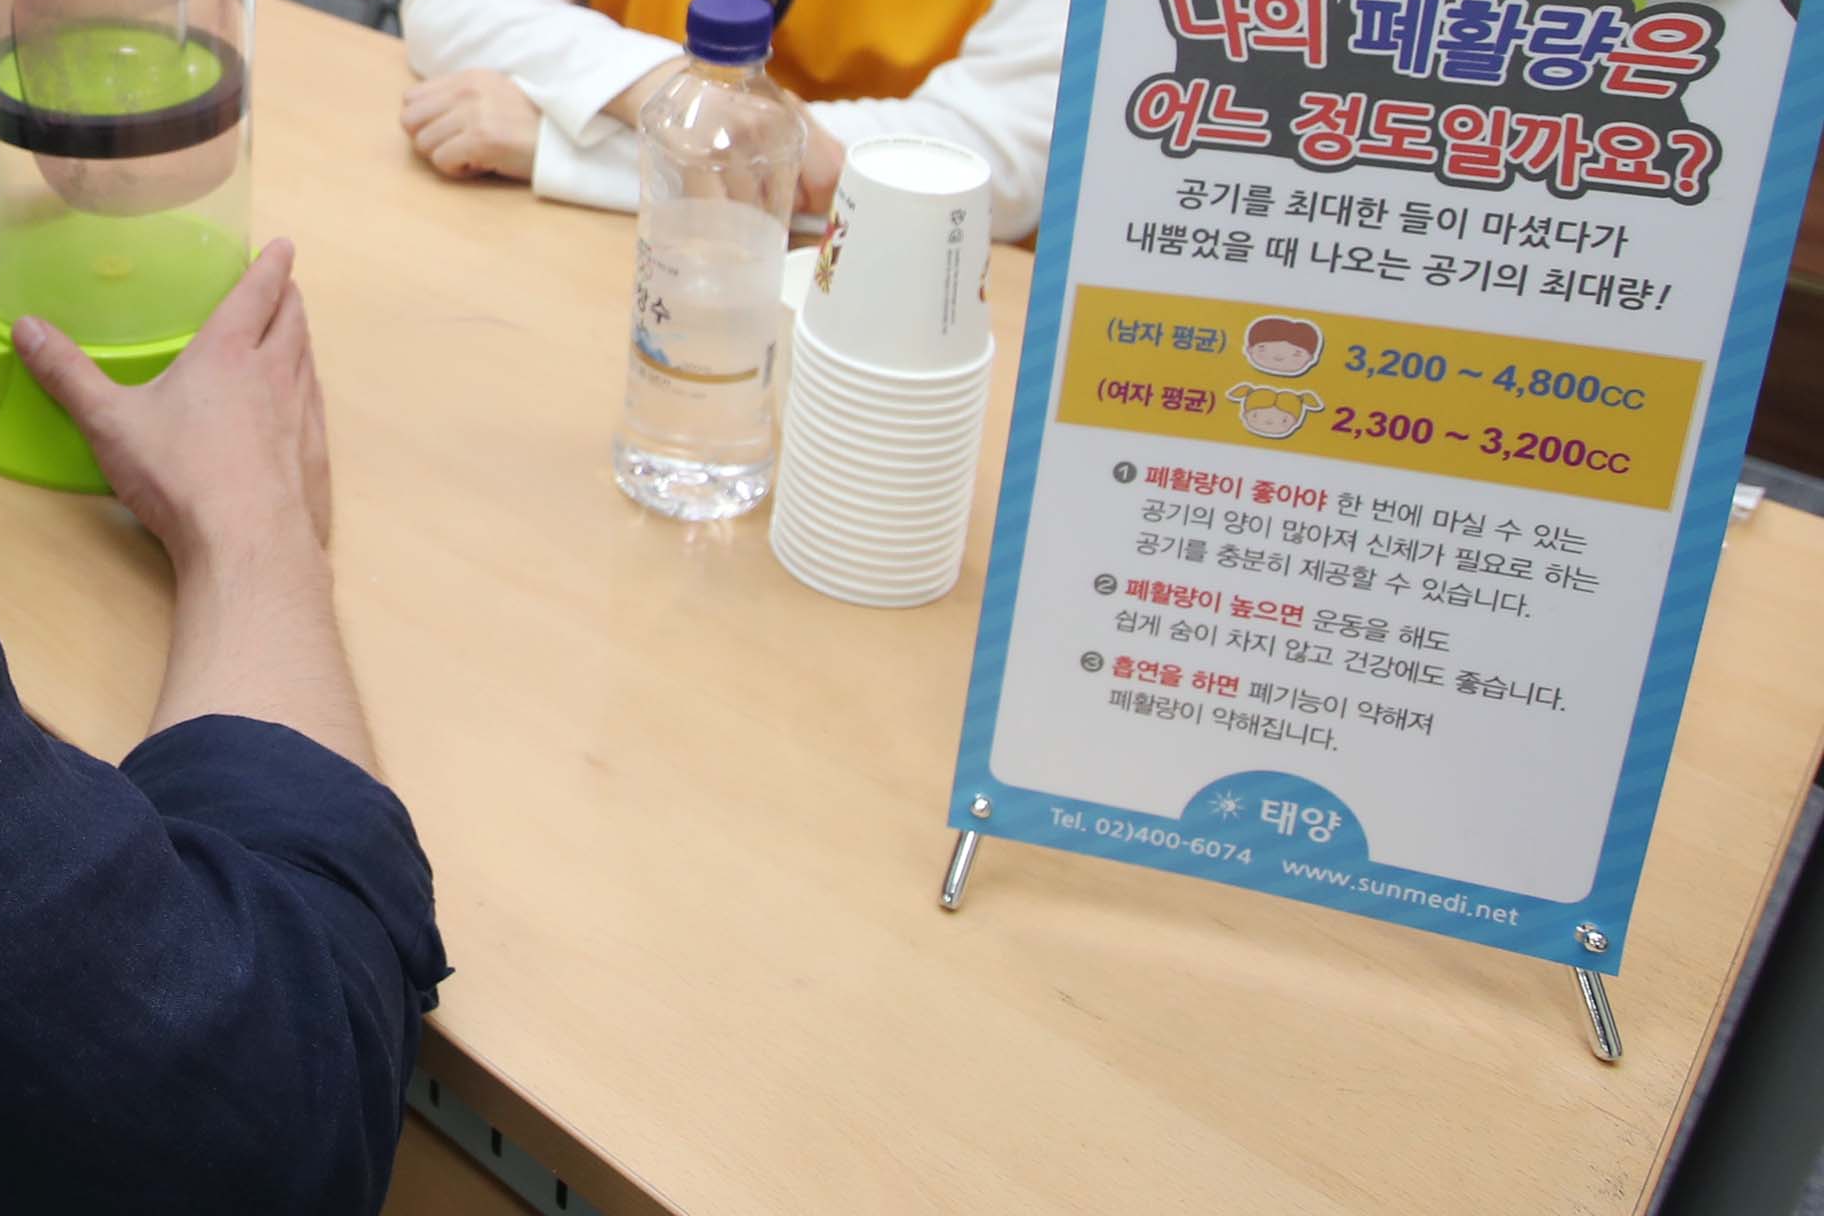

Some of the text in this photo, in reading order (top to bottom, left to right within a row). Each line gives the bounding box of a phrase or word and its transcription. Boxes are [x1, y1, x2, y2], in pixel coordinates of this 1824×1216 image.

[1134, 79, 1712, 196] 어느 정도일까요?
[1176, 178, 1630, 259] 공기를 최대한 들이 마셨다가
[1125, 222, 1673, 311] 내뿜었을 때 나오는 공기의 최대량!
[1107, 317, 1228, 353] (남자 평균)
[1344, 344, 1447, 382] 3,200
[1097, 378, 1217, 414] (여자 평균)
[1330, 406, 1434, 444] 2,300
[1141, 498, 1601, 594] 공기의 양이 많아져 신체가 필요로 하는
[1144, 466, 1243, 499] 폐활량이
[1252, 479, 1328, 512] 좋아야
[1337, 492, 1363, 518] 한
[1371, 498, 1424, 528] 번에
[1432, 509, 1487, 538] 마실
[1494, 518, 1523, 542] 수
[1533, 524, 1588, 555] 있는
[1135, 531, 1532, 619] 공기를 충분히 제공할 수 있습니다.
[1124, 578, 1222, 614] 폐활량이
[1230, 594, 1305, 628] 높으면
[1312, 608, 1390, 643] 운동을
[1398, 624, 1451, 653] 해도
[1112, 655, 1183, 688] 흡연을
[1192, 670, 1241, 698] 하면
[1247, 680, 1348, 719] 폐기능이
[1357, 700, 1434, 736] 약해져
[1115, 608, 1566, 712] 쉽게 숨이 차지 않고 건강에도 좋습니다.
[1108, 688, 1338, 751] 폐활량이 약해집니다.
[1050, 807, 1253, 865] Tel. 02)400-6074
[1259, 799, 1343, 843] 태양
[1282, 859, 1520, 926] www.sunmedi.net
